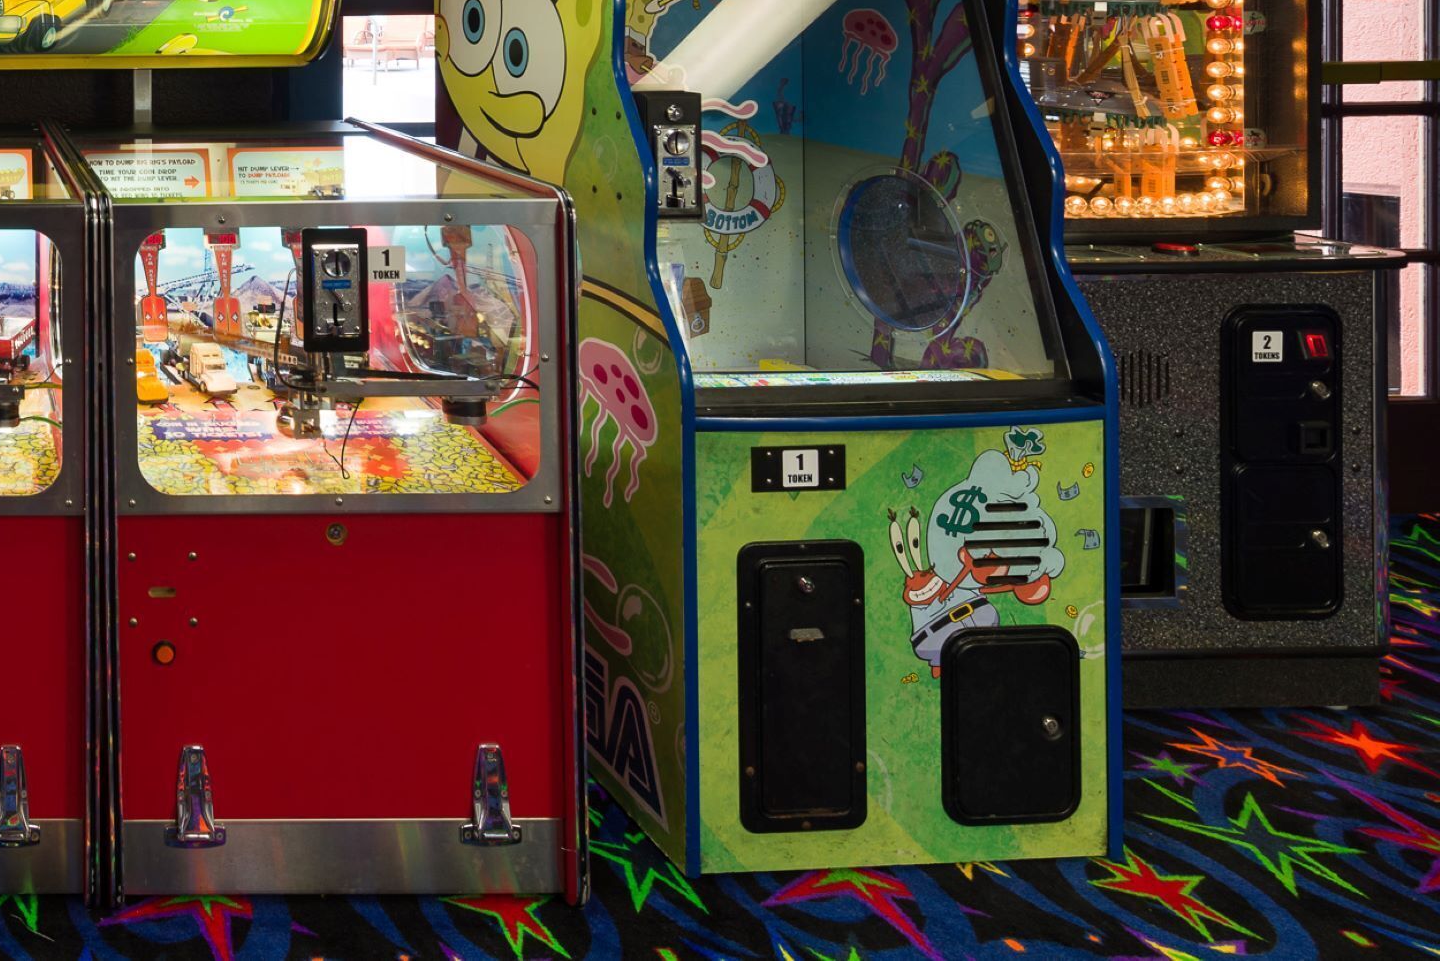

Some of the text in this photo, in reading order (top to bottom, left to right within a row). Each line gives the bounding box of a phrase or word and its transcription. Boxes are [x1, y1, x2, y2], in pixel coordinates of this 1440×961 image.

[706, 209, 759, 230] BOTTOM
[382, 249, 390, 266] 1
[373, 270, 400, 280] TOKEN
[1263, 336, 1272, 350] 2
[1254, 352, 1281, 360] TOKENS
[795, 453, 804, 471] 1
[787, 473, 813, 484] TOKEN
